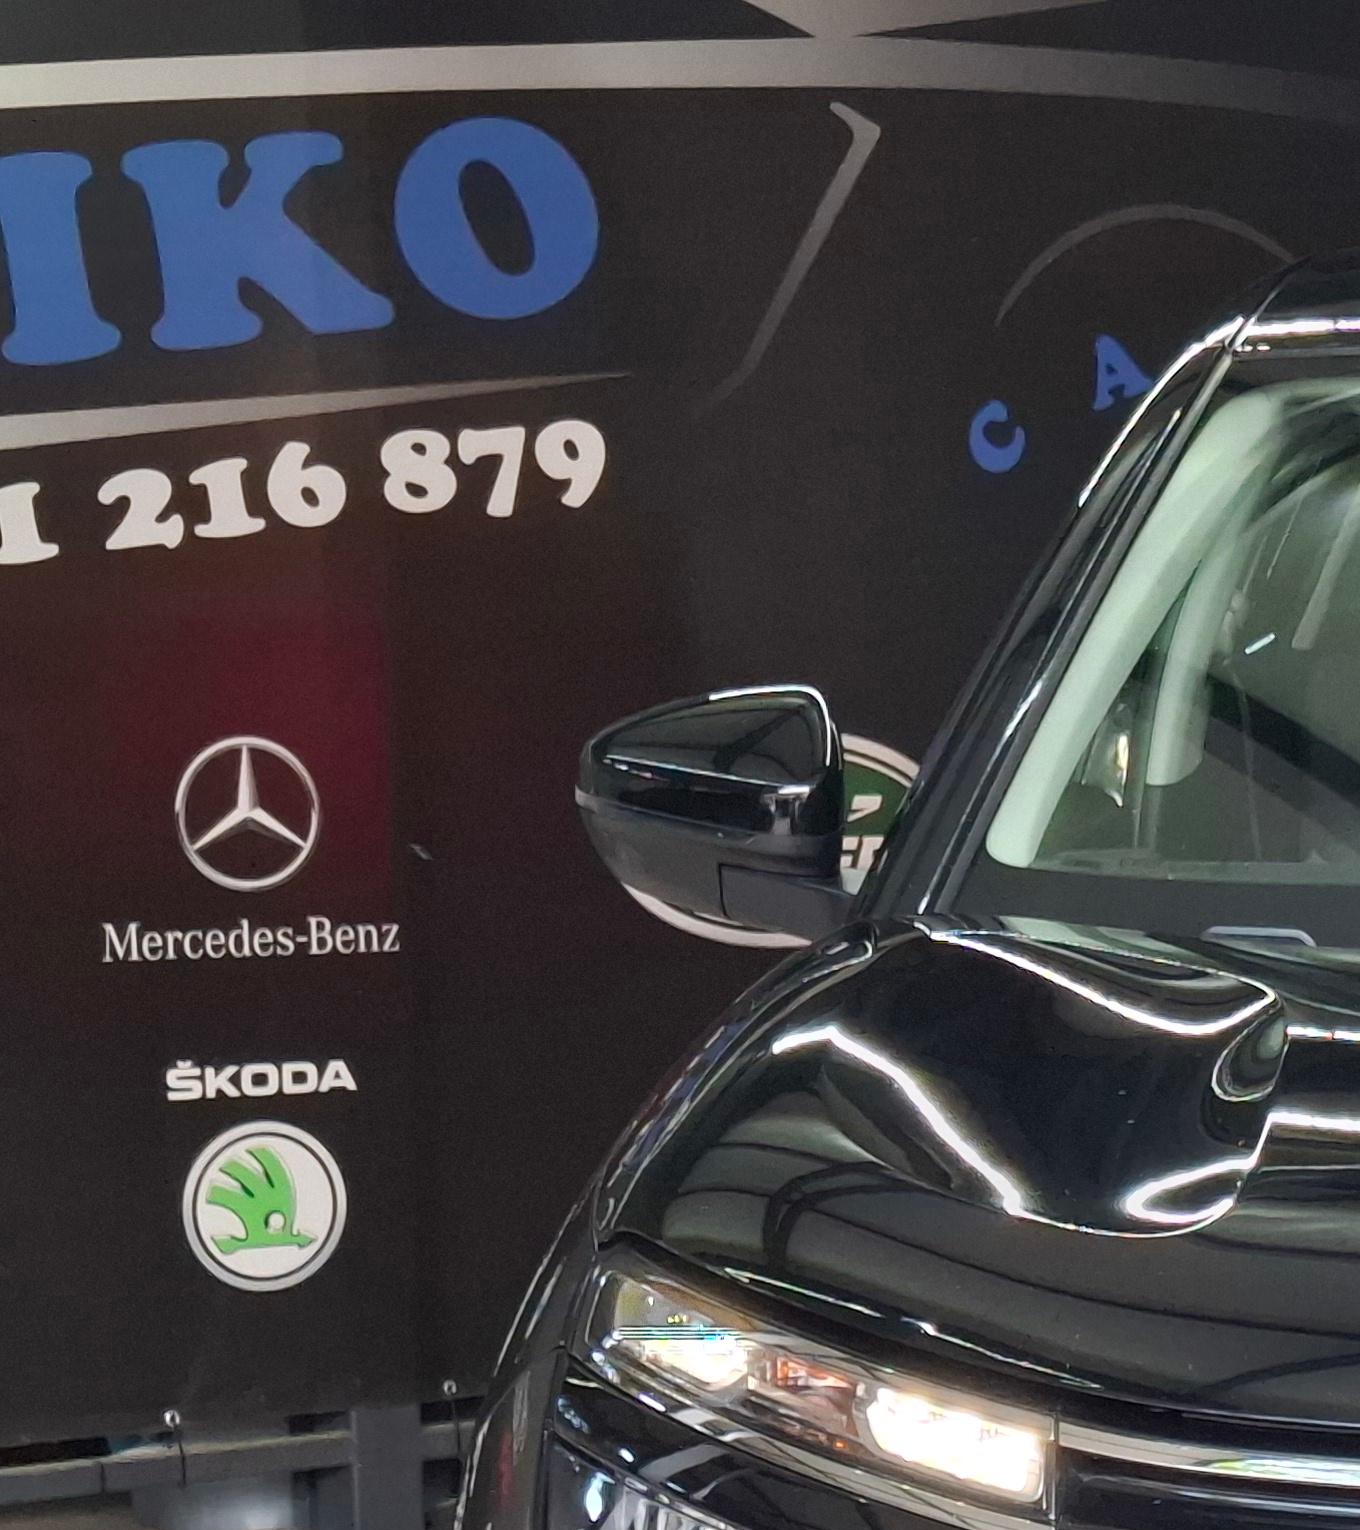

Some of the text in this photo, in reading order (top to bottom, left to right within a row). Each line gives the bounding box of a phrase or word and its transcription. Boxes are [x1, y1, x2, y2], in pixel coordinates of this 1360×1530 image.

[97, 442, 347, 552] 216
[380, 419, 606, 519] 879
[102, 915, 400, 963] Mercedes-Benz
[165, 1059, 358, 1101] ŠKODA
